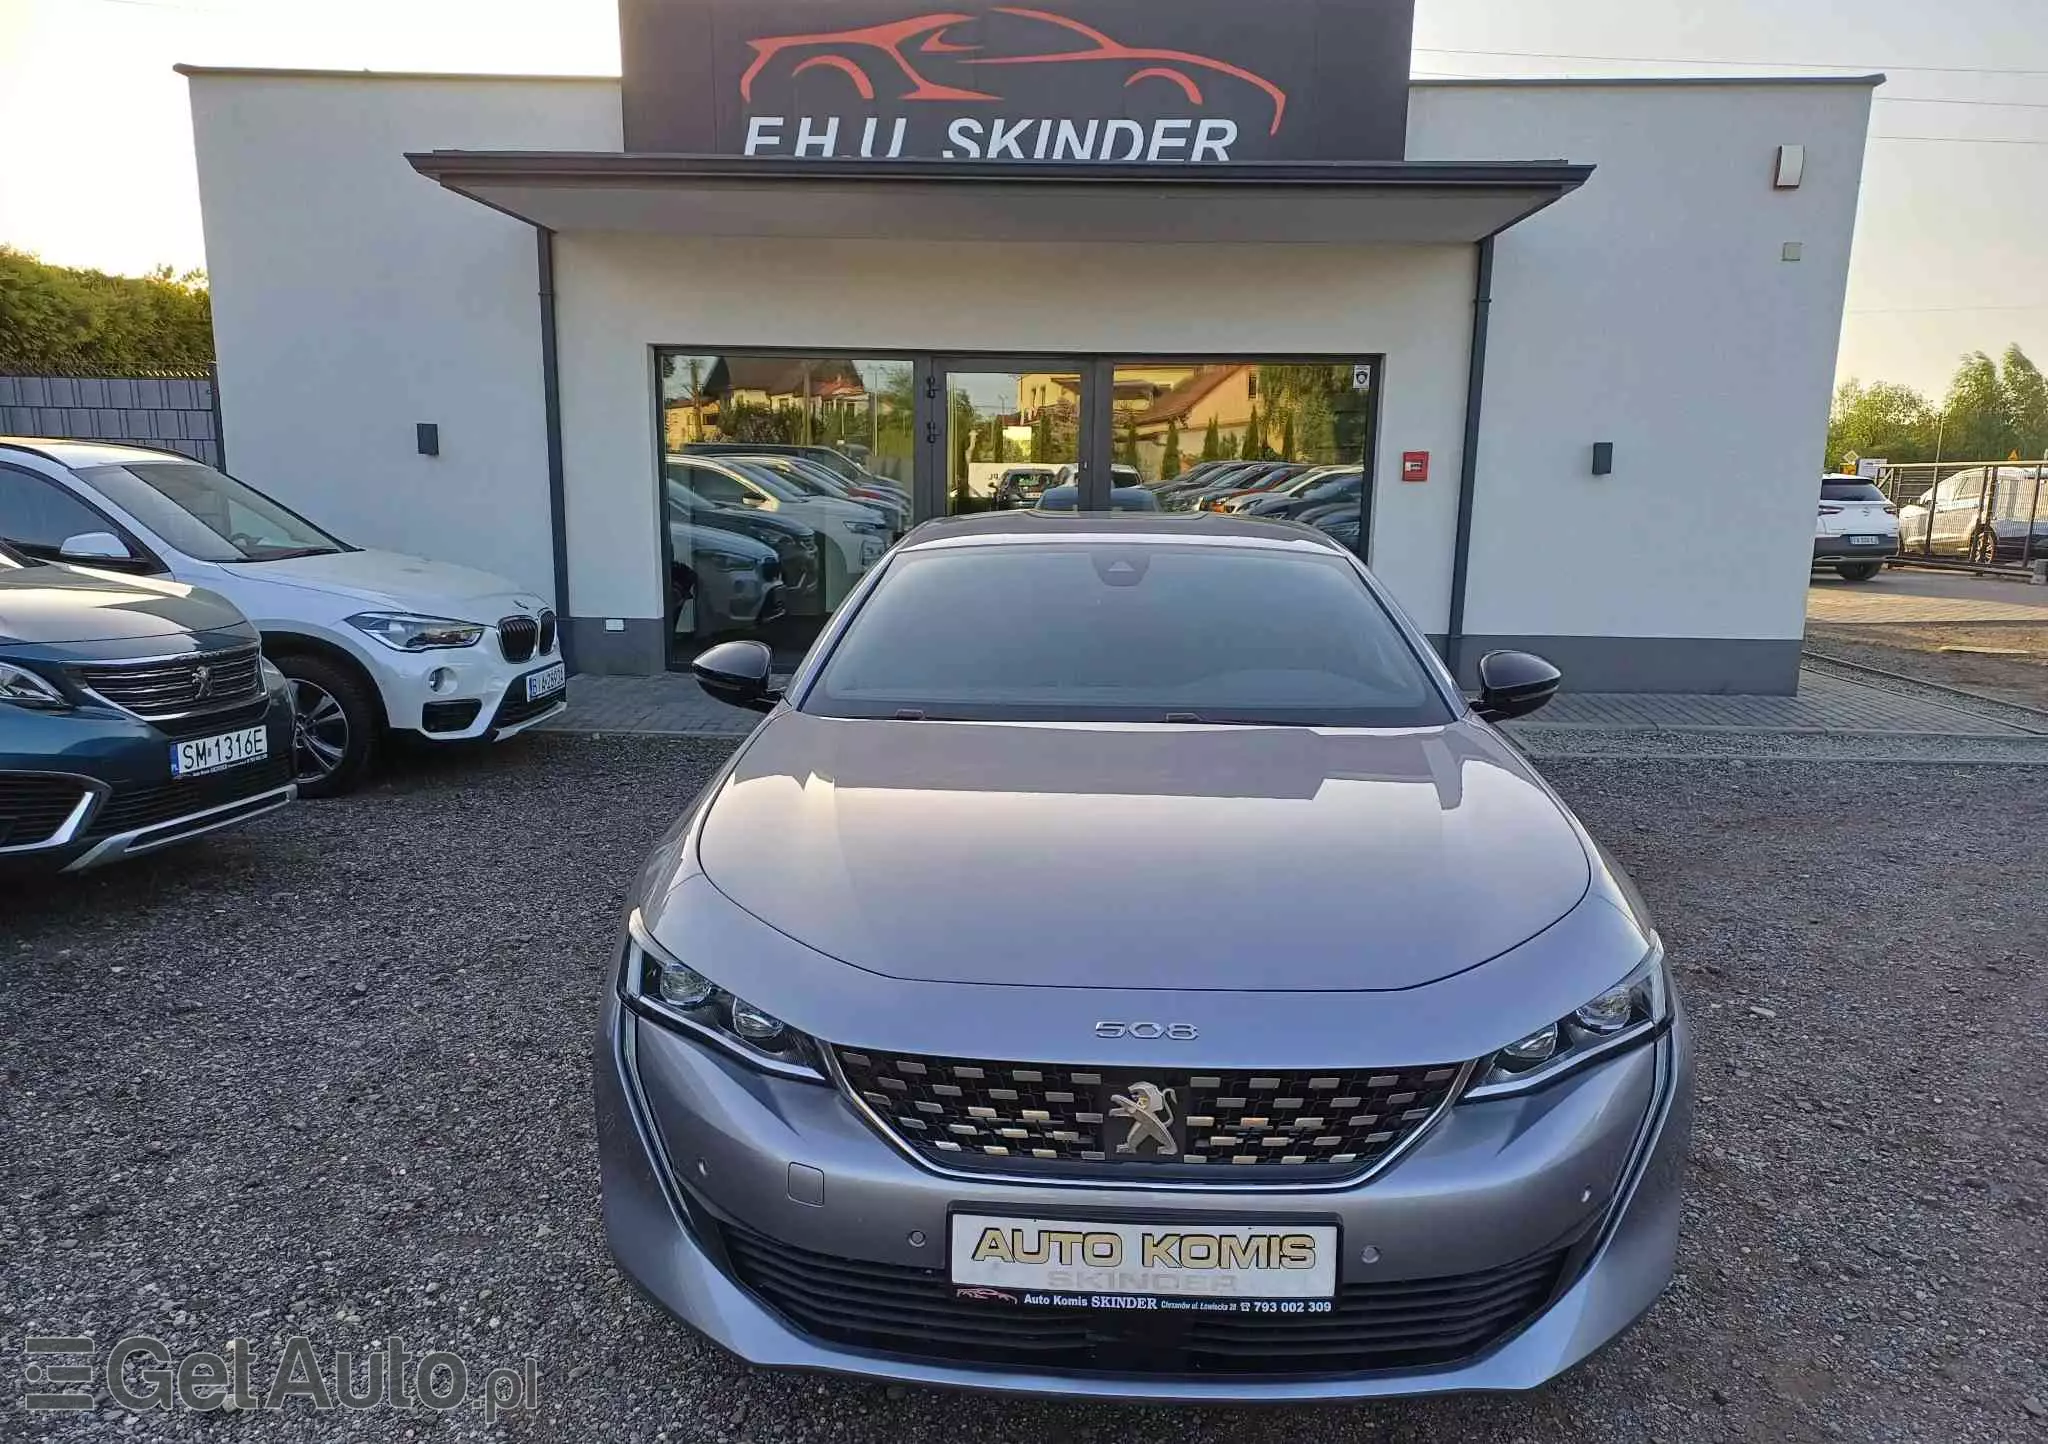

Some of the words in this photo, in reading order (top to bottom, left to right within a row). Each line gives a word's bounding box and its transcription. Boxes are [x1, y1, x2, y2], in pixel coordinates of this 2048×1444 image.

[942, 117, 1238, 161] SKINDER
[182, 741, 207, 769] SM
[214, 728, 263, 763] 1316E
[1095, 1021, 1200, 1041] 508
[972, 1227, 1123, 1268] AUTO
[1142, 1233, 1317, 1270] KOMIS
[1024, 1293, 1050, 1305] Auto
[1053, 1295, 1088, 1306] Komis
[1091, 1296, 1158, 1309] SKINDER
[1254, 1302, 1277, 1312] 793
[1281, 1302, 1305, 1313] 002
[1308, 1302, 1332, 1313] 309
